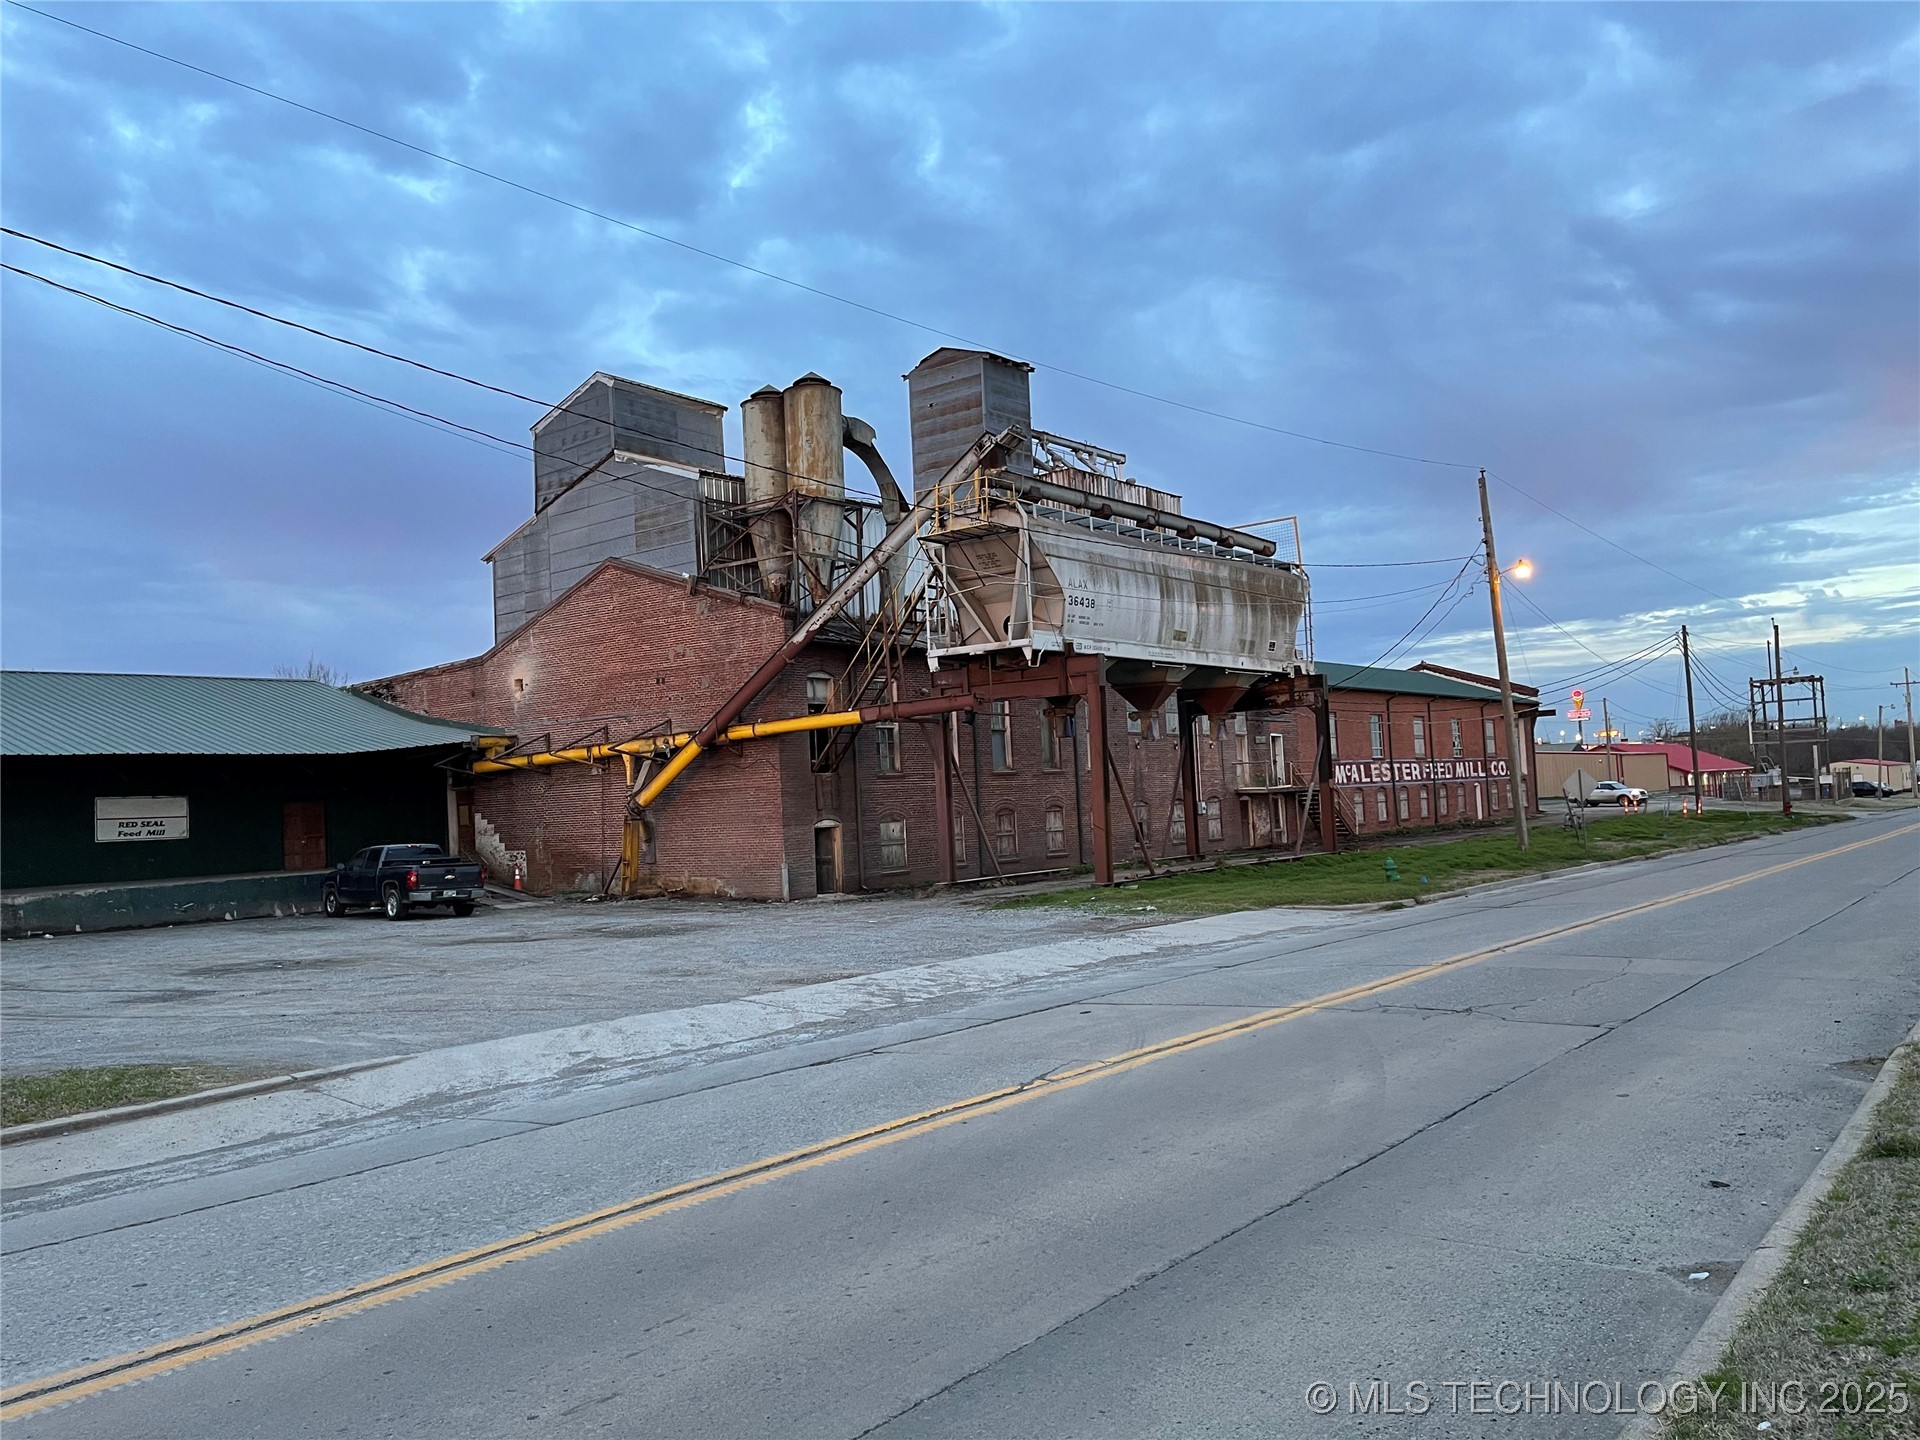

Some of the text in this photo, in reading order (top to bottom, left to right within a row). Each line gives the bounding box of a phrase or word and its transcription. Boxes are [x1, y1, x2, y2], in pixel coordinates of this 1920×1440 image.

[1068, 595, 1095, 608] 36438
[1422, 762, 1453, 780] FEED
[1455, 761, 1486, 778] MILL
[1490, 760, 1511, 776] CO.
